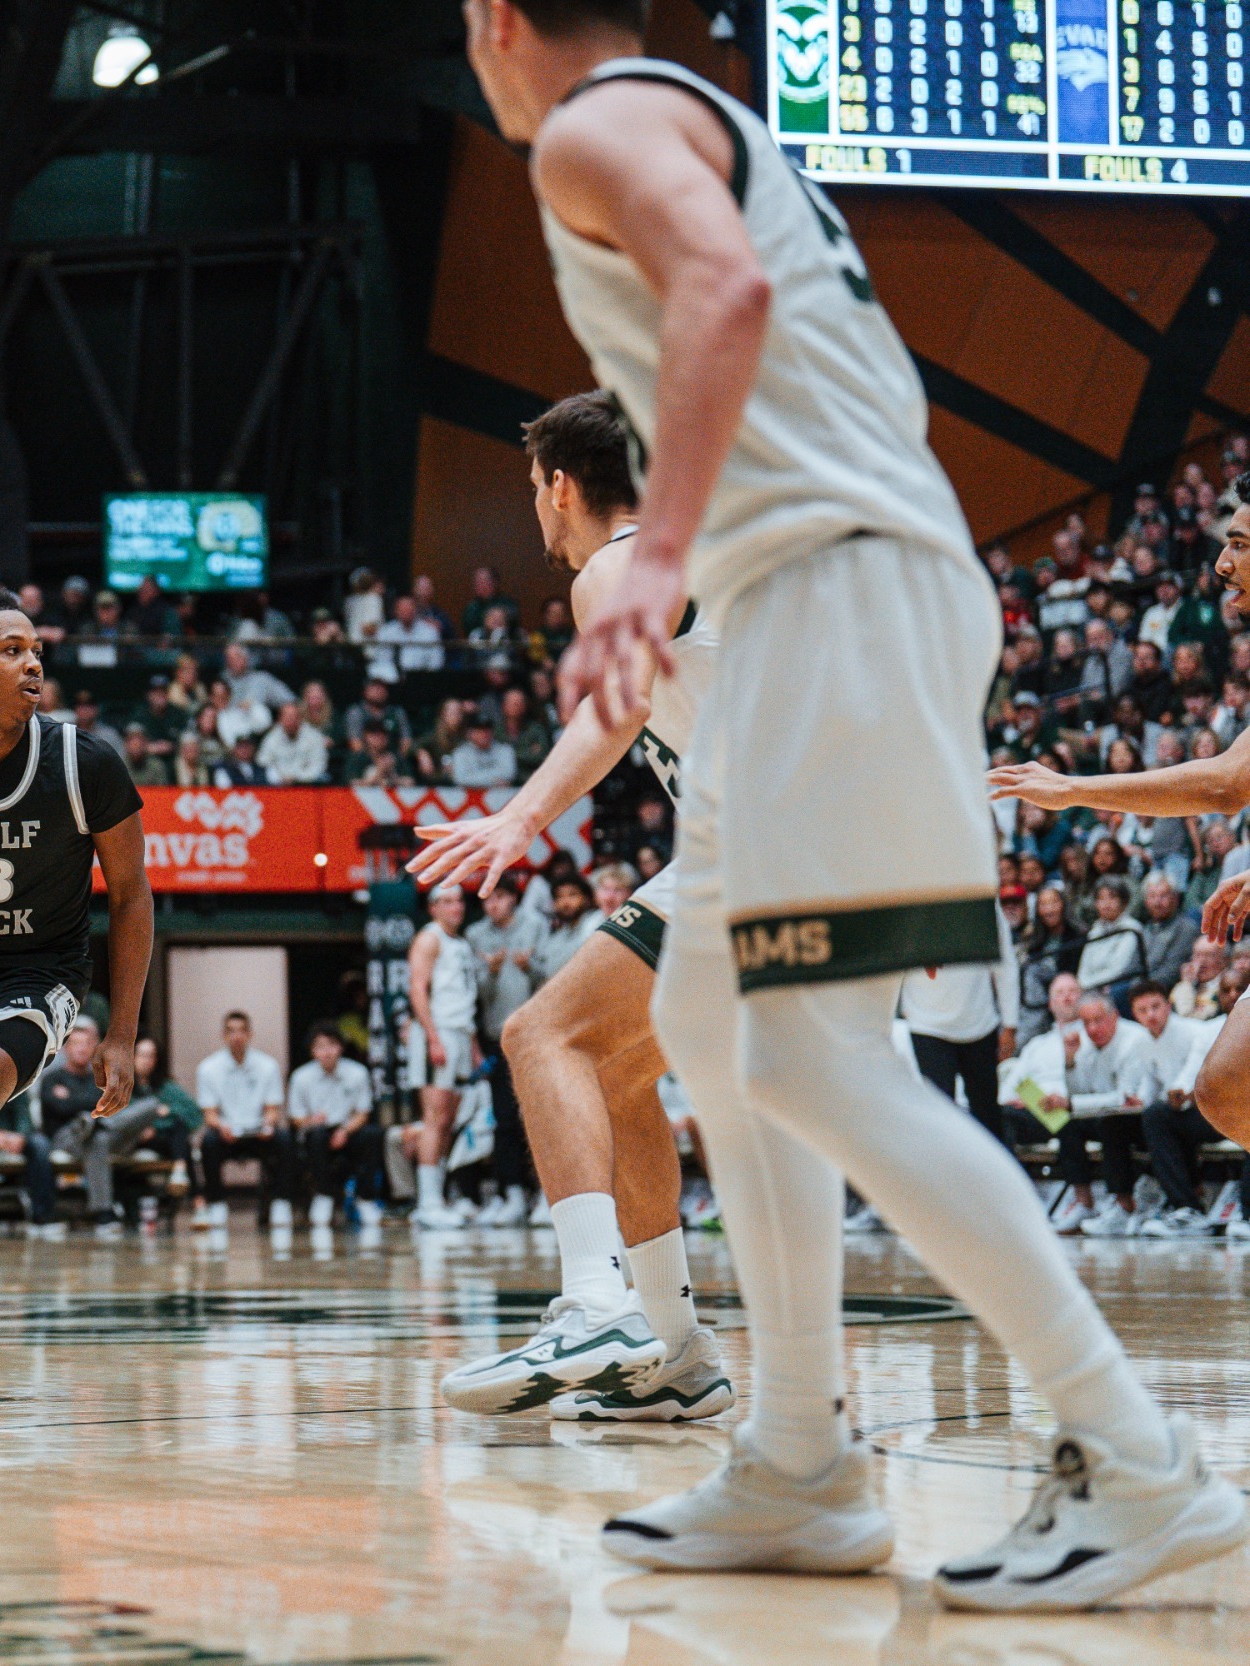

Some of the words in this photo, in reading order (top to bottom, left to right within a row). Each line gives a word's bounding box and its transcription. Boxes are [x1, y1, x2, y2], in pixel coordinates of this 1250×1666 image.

[1226, 4, 1242, 28] 0
[843, 16, 860, 41] 3
[875, 17, 892, 43] 0
[910, 19, 926, 44] 2
[945, 21, 962, 46] 0
[981, 22, 995, 47] 1
[1124, 28, 1137, 53] 1
[1156, 30, 1173, 54] 4
[1227, 33, 1243, 57] 0
[842, 46, 861, 71] 4
[876, 47, 893, 73] 0
[911, 48, 927, 74] 2
[946, 50, 960, 75] 1
[981, 51, 998, 77] 0
[1124, 58, 1139, 82] 3
[1192, 60, 1208, 85] 3
[1227, 62, 1243, 86] 0
[876, 76, 892, 102] 2
[911, 78, 929, 104] 0
[946, 79, 962, 105] 2
[981, 81, 998, 106] 0
[1124, 87, 1139, 112] 7
[1228, 91, 1241, 116] 1
[911, 107, 928, 133] 3
[947, 109, 961, 134] 1
[982, 110, 996, 136] 1
[1159, 117, 1174, 142] 2
[1194, 119, 1210, 144] 0
[1228, 120, 1244, 145] 0
[806, 144, 887, 173] FOULS
[896, 149, 911, 173] 1
[1085, 155, 1163, 183] FOULS
[1171, 159, 1189, 184] 4
[144, 832, 249, 867] nvas
